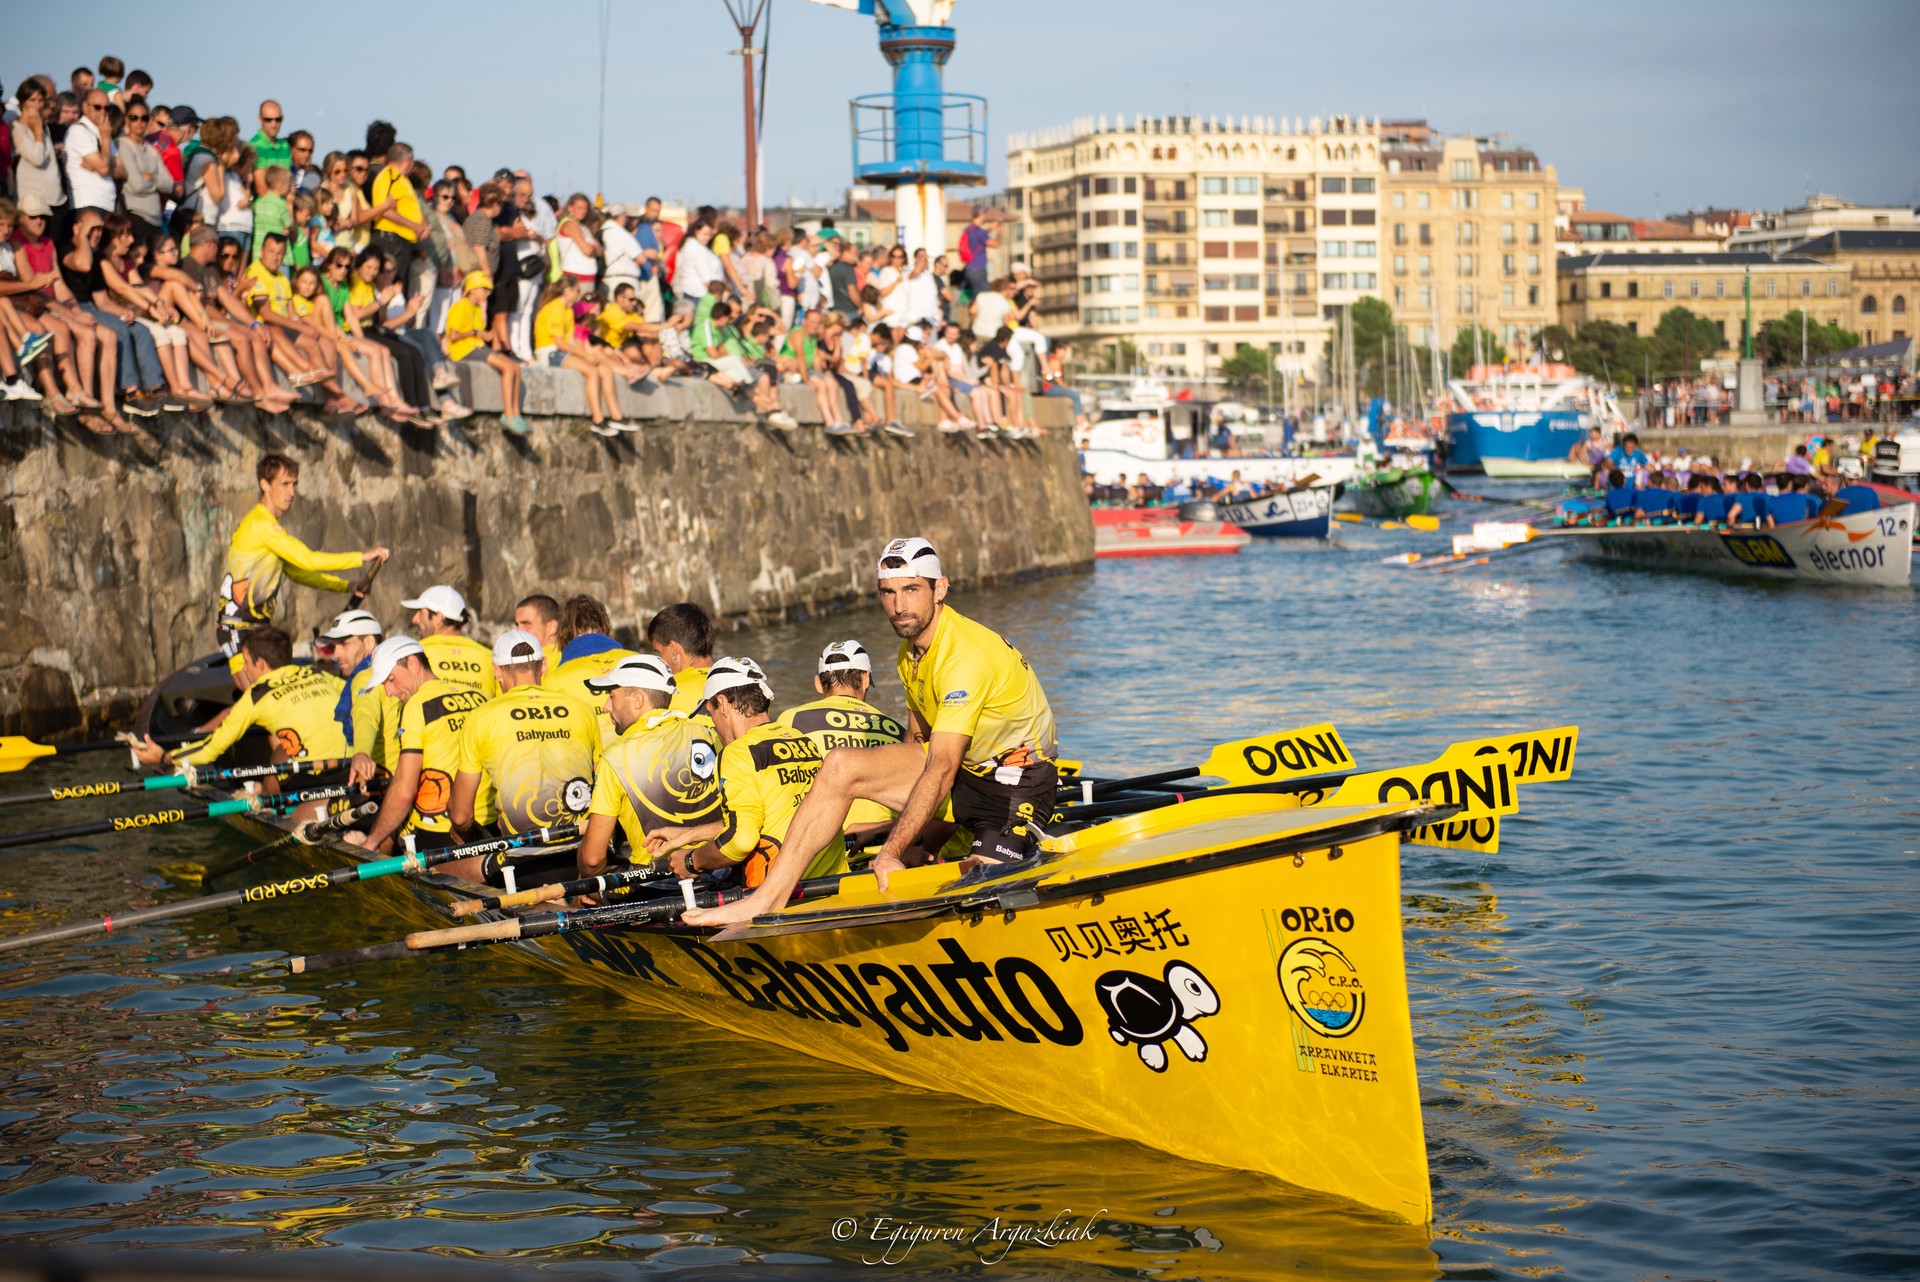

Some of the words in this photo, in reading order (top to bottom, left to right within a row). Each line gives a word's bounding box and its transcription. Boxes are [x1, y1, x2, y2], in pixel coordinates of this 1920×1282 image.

[1877, 517, 1897, 537] 12
[1809, 544, 1885, 571] elecnor
[516, 728, 570, 742] Babyauto
[1243, 731, 1348, 777] INDO
[232, 764, 278, 779] CaixaBank
[53, 782, 120, 800] SAGARDI
[300, 785, 347, 802] CaixaBank
[114, 809, 184, 831] SAGARDI
[452, 839, 508, 860] CaixaBank
[245, 873, 329, 901] SAGARDI
[1044, 907, 1190, 963] 贝贝奥托
[1328, 975, 1363, 989] C.R.O.
[676, 935, 1083, 1053] Babyauto
[1320, 1063, 1378, 1083] ELKARTEA
